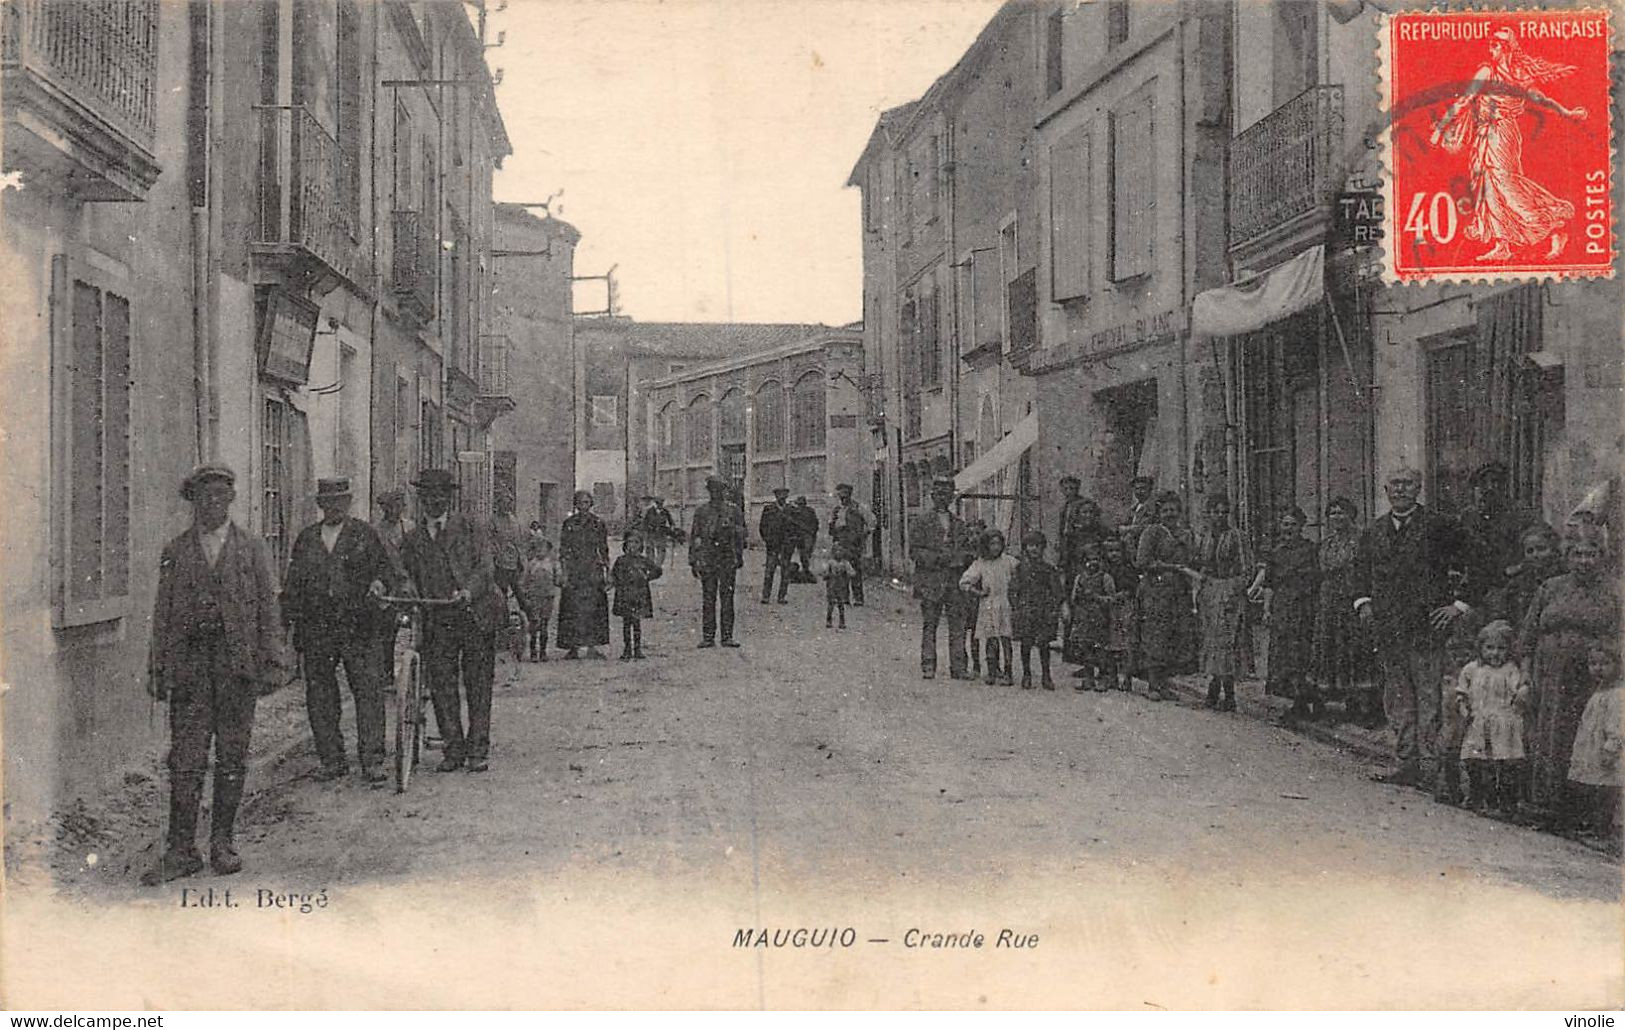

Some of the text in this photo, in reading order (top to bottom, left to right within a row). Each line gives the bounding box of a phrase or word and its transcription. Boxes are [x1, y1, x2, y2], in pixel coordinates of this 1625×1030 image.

[1519, 20, 1605, 39] FRANÇAISE
[1586, 170, 1605, 254] POSTES
[257, 888, 329, 914] Bergé
[732, 927, 857, 949] MAUGUIO
[996, 928, 1040, 949] Rue
